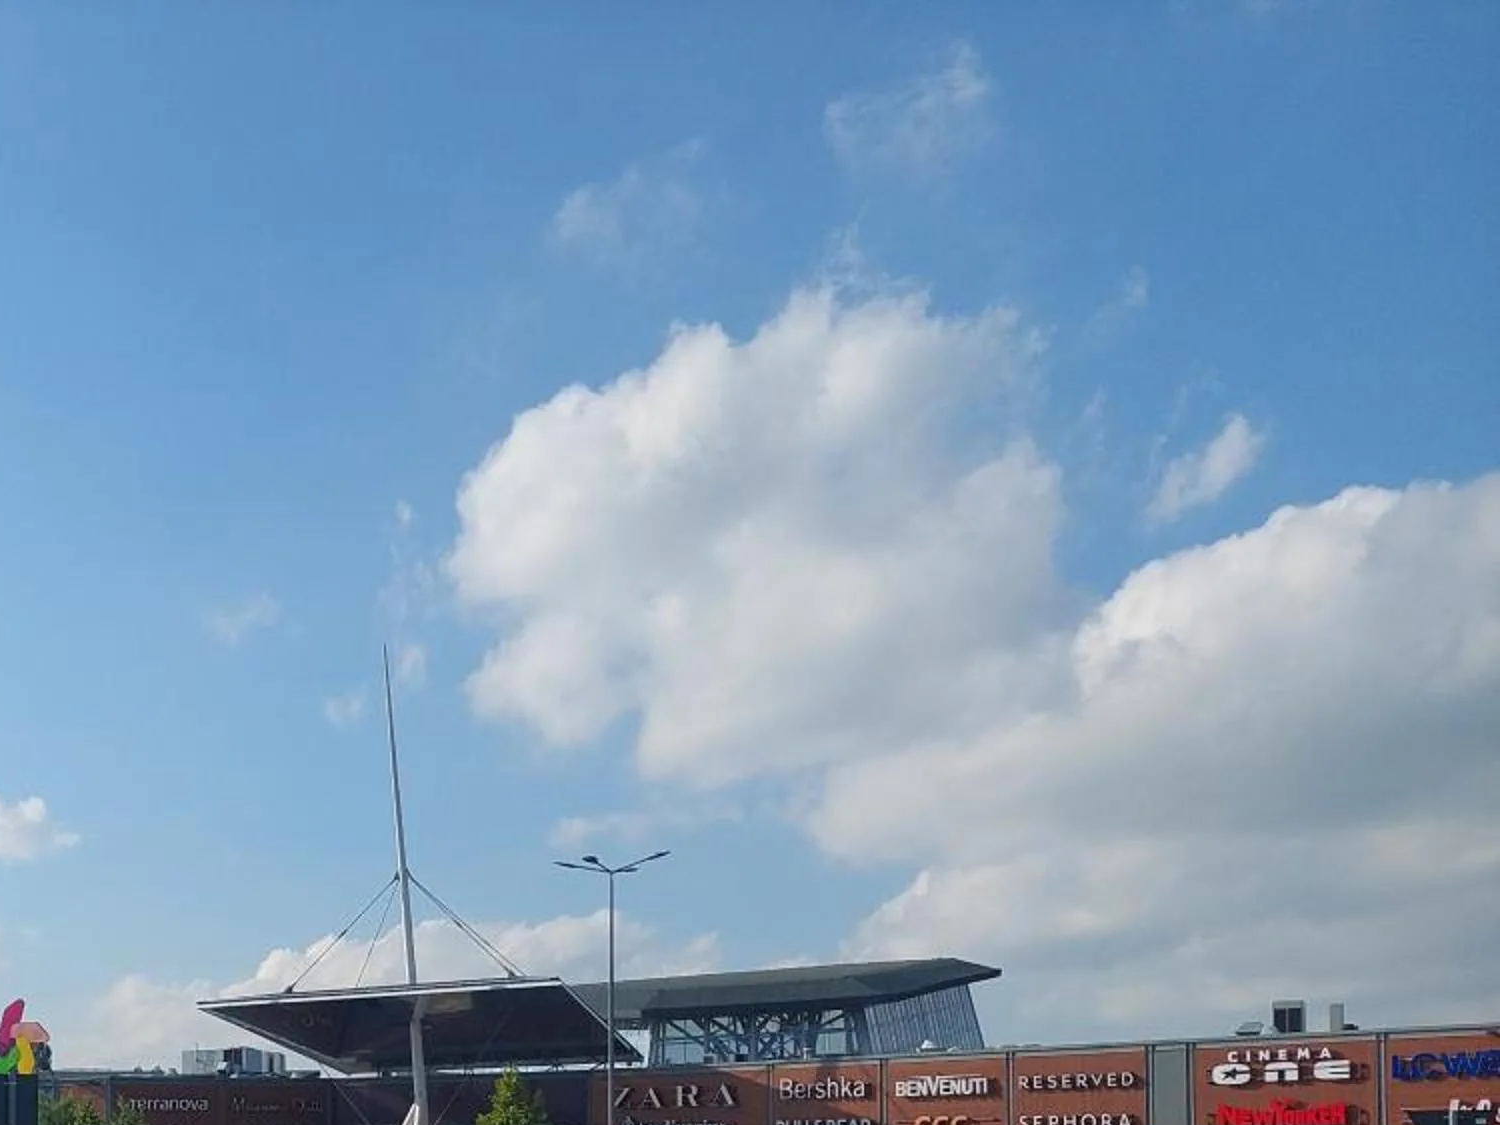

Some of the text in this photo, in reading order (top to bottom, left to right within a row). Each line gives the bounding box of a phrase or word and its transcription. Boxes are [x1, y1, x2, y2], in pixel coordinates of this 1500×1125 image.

[1227, 1047, 1332, 1062] CINEMA
[779, 1076, 866, 1098] Bershka
[895, 1075, 988, 1097] BENVENUTI
[1018, 1072, 1134, 1089] RESERVED
[613, 1083, 735, 1108] ZARA
